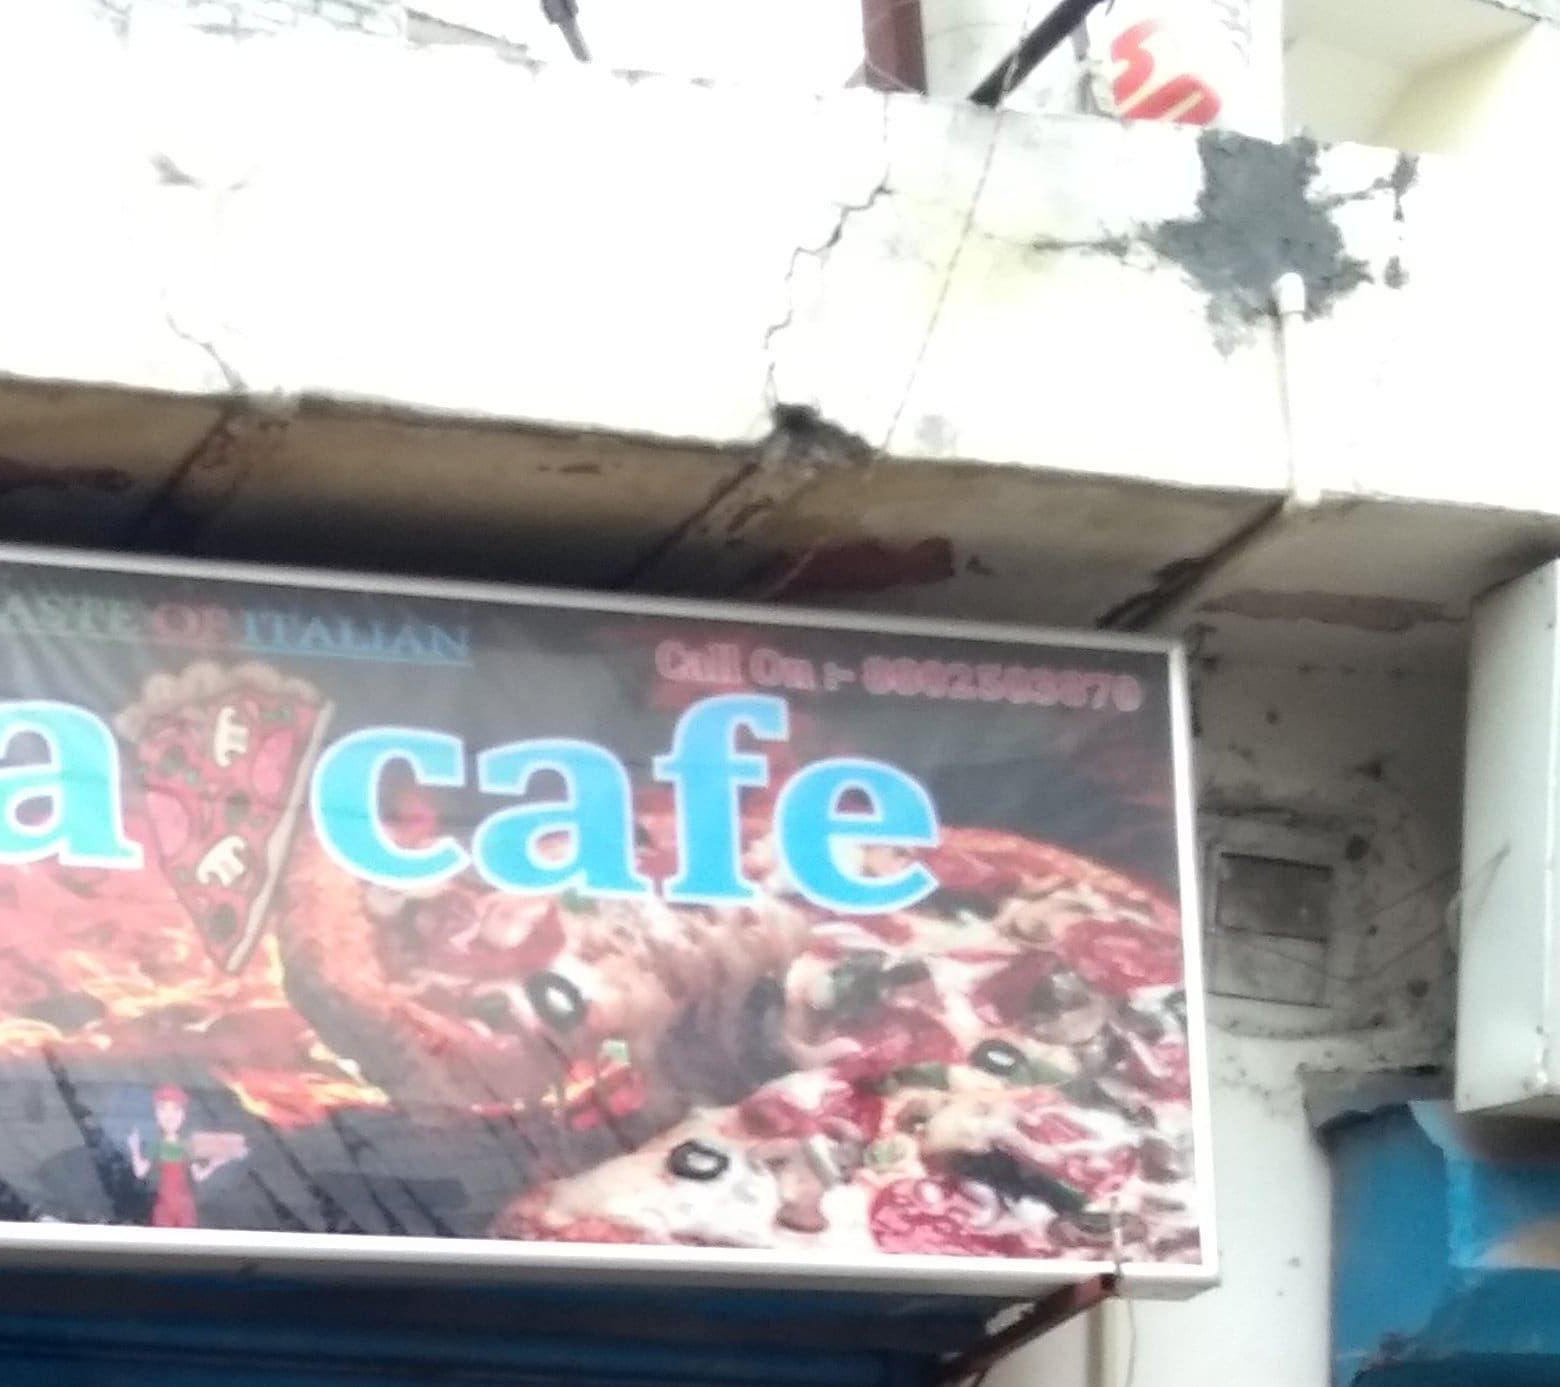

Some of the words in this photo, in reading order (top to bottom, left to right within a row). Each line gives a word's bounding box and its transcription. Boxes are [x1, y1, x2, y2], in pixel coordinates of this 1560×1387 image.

[148, 598, 233, 644] OF
[241, 606, 473, 664] ITALIAN
[654, 639, 741, 684] Call
[311, 693, 941, 913] cafe
